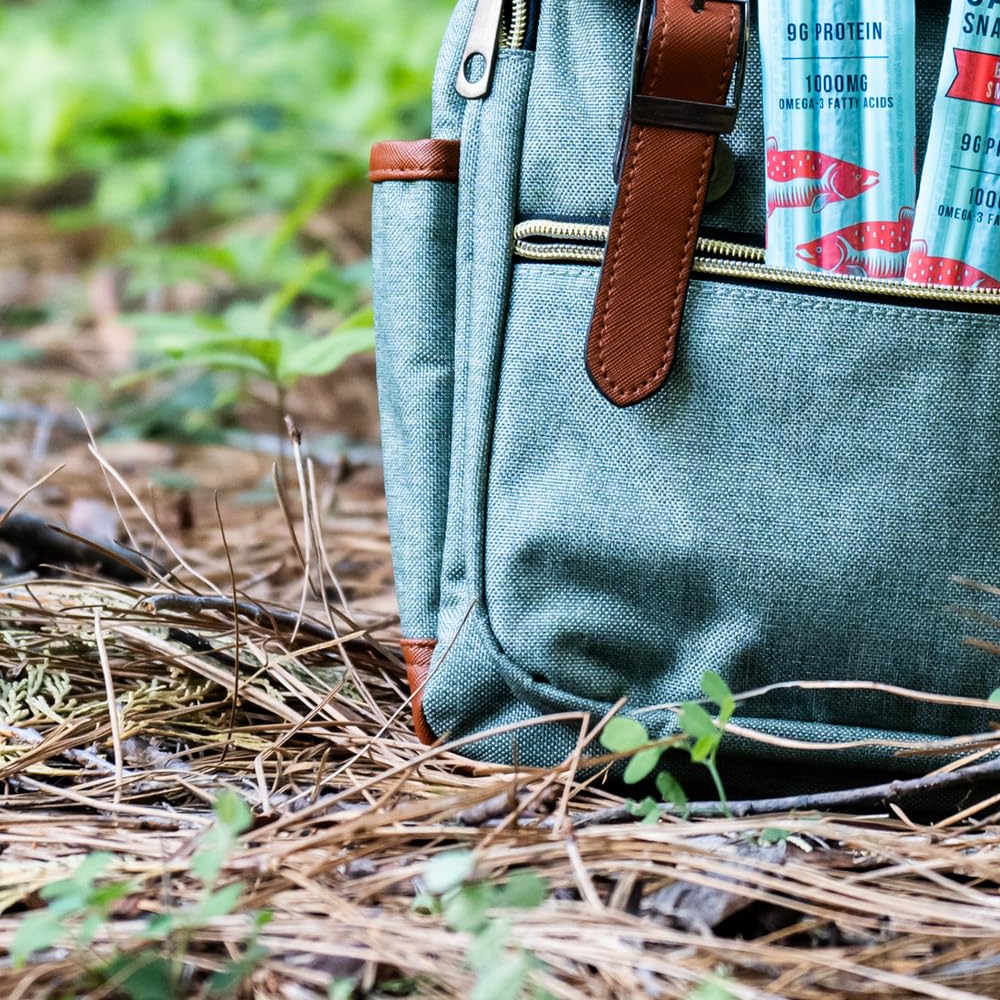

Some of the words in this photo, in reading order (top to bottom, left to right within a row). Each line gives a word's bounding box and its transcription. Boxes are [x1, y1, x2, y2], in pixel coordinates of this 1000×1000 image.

[787, 22, 809, 42] 9G
[815, 21, 883, 41] PROTEIN
[805, 73, 868, 93] 1000MG
[778, 97, 824, 110] OMEGA-3
[828, 96, 860, 110] FATTY
[863, 96, 894, 109] ACIDS
[960, 133, 982, 153] 9G
